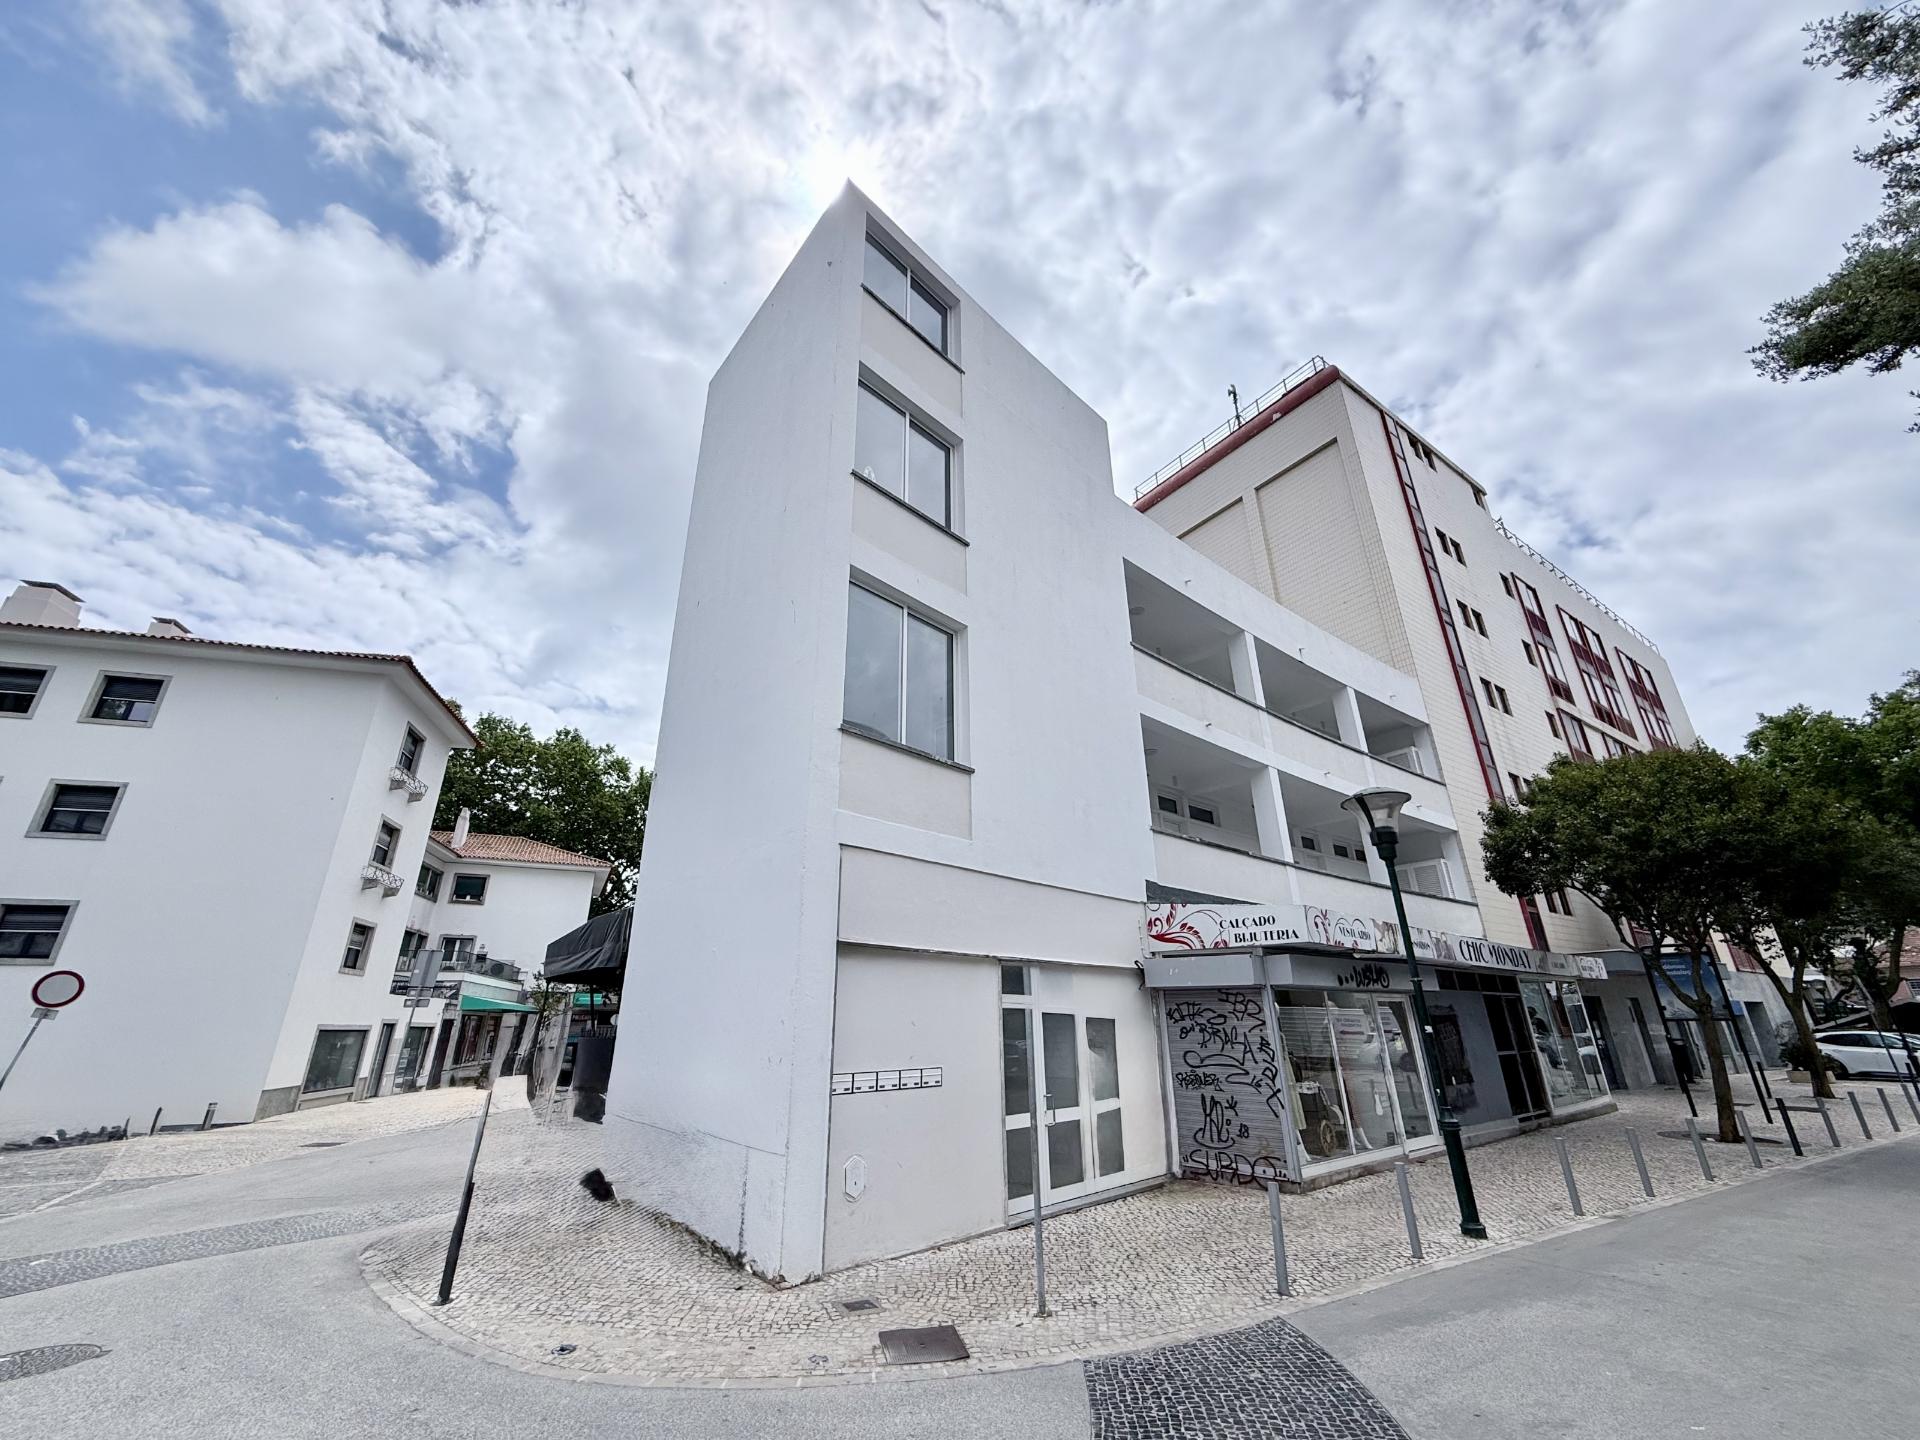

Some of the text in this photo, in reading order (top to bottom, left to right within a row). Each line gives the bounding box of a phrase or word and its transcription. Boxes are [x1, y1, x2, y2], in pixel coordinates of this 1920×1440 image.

[1219, 915, 1276, 930] CALÇADO
[1234, 928, 1300, 943] BIJUTERIA
[1458, 939, 1532, 969] CHIC MONDAY
